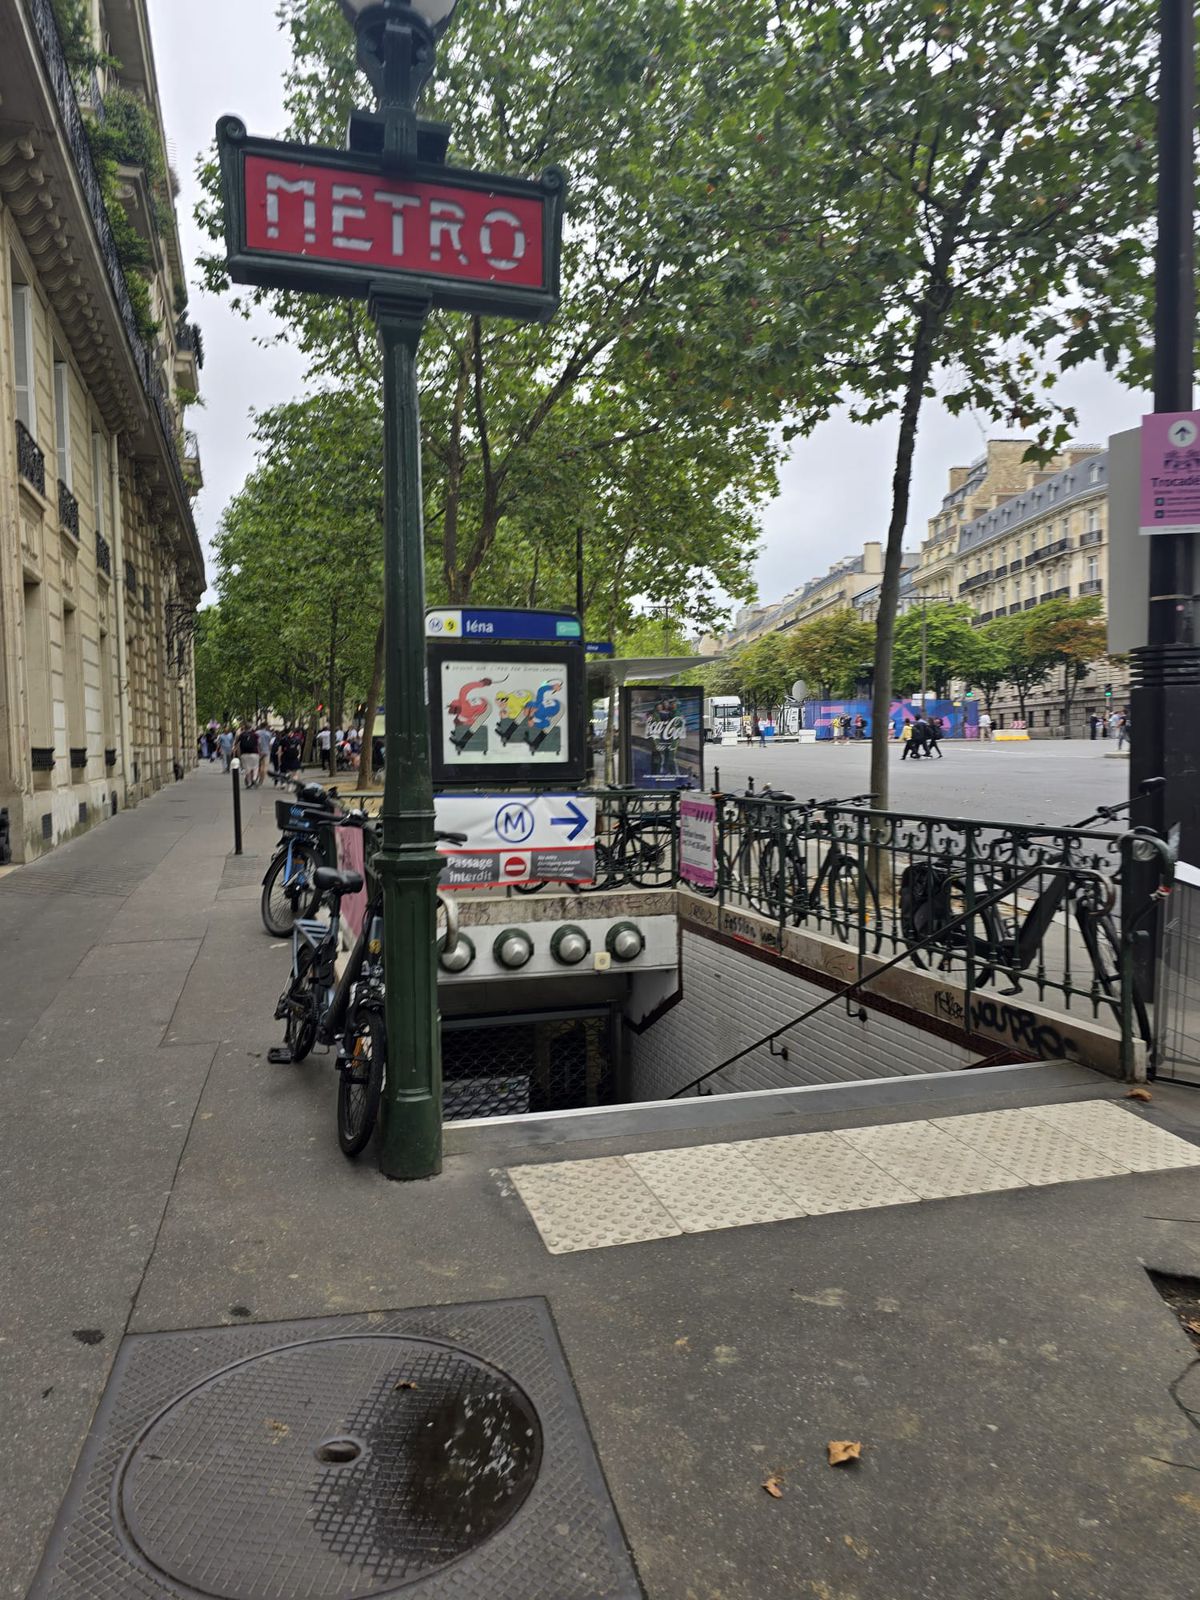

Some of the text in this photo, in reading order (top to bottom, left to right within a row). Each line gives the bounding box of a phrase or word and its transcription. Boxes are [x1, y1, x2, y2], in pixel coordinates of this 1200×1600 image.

[265, 172, 526, 271] METRO
[466, 620, 494, 633] Iéna
[447, 857, 493, 871] Passage
